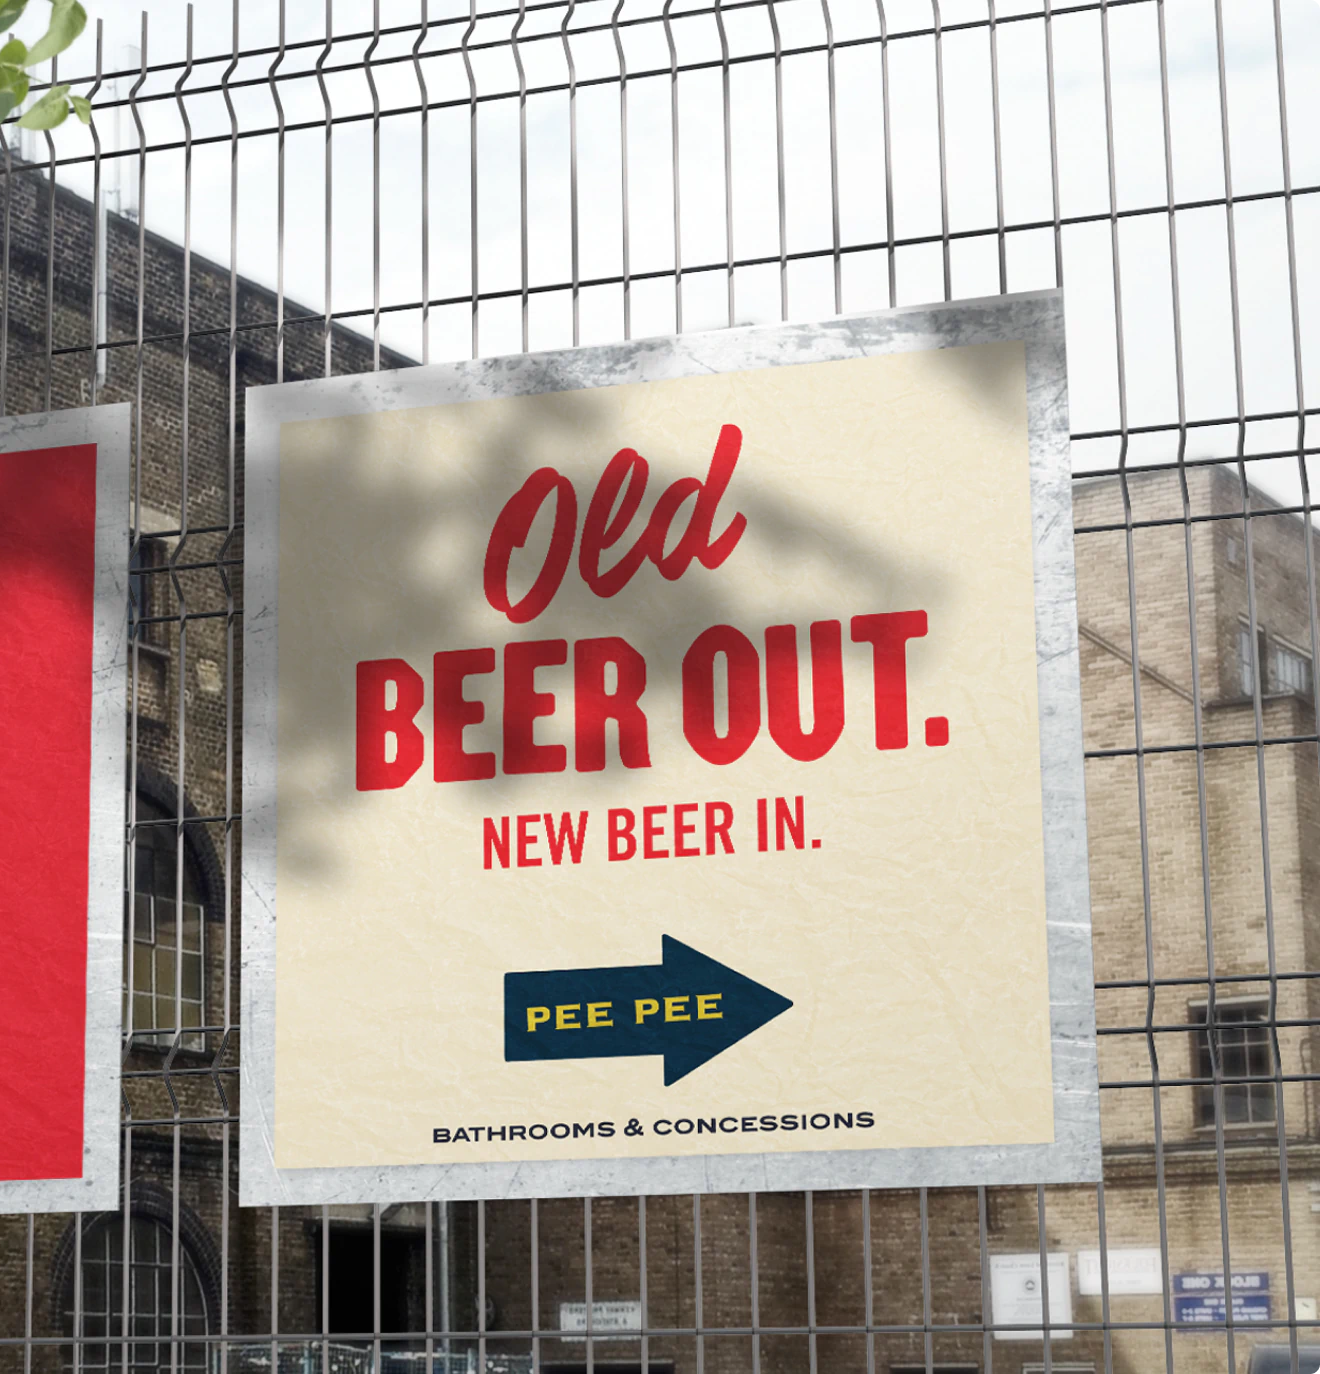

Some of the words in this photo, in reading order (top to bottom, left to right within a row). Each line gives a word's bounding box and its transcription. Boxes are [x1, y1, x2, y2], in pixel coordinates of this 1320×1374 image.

[483, 424, 747, 624] Old
[356, 636, 652, 792] BEER
[682, 610, 949, 765] OUT.
[483, 811, 590, 870] NEW
[608, 801, 735, 861] BEER
[757, 796, 822, 852] IN.
[526, 1001, 614, 1032] PEE
[634, 993, 724, 1025] PEE
[432, 1121, 616, 1144] BATHROOMS
[622, 1118, 644, 1137] &
[652, 1111, 875, 1136] CONCESSIONS
